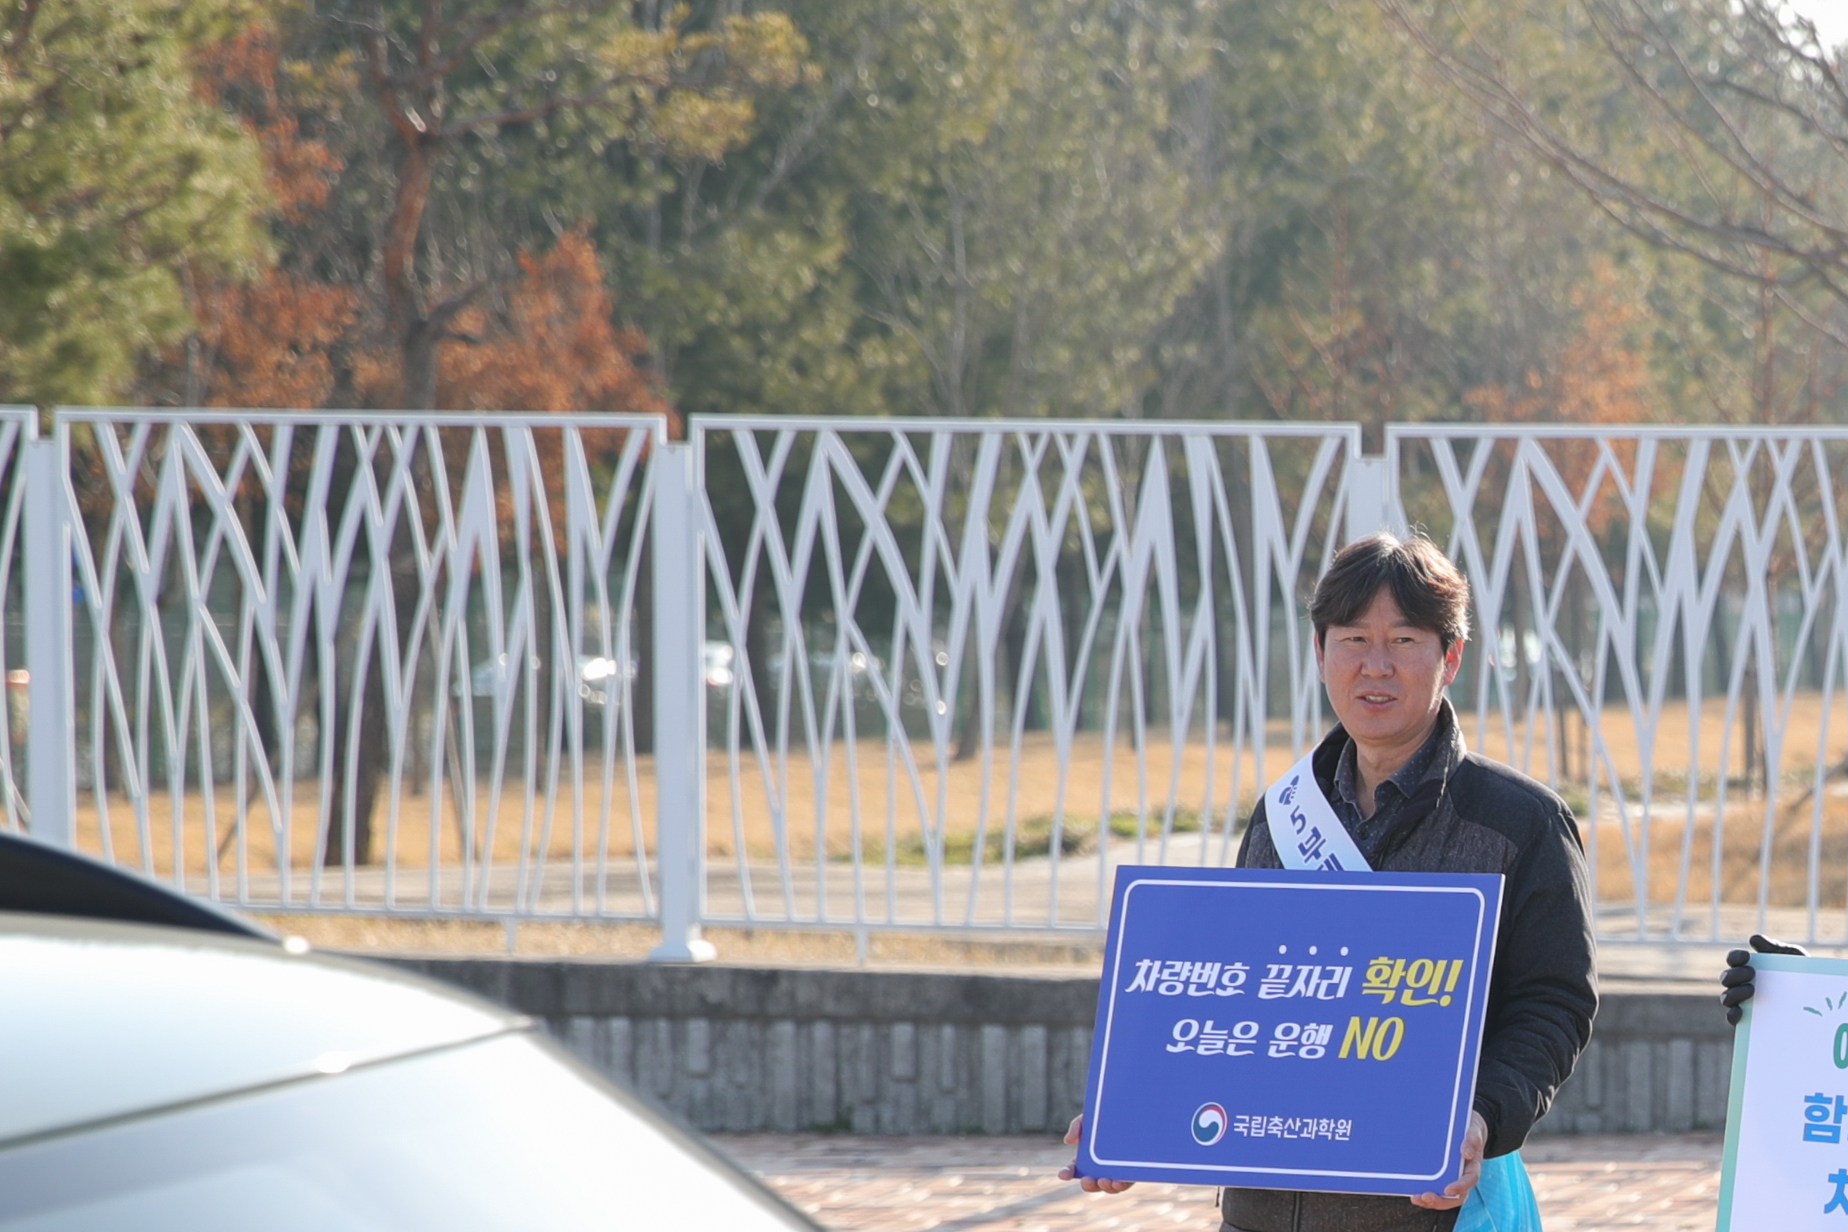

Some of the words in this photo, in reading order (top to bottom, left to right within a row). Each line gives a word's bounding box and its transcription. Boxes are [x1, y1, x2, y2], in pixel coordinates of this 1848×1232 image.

[1125, 958, 1250, 997] 차량번호
[1258, 964, 1353, 1000] 끝자리
[1361, 956, 1464, 1007] 확인!
[1166, 1018, 1260, 1056] 오늘은
[1267, 1022, 1333, 1060] 운행
[1338, 1016, 1405, 1062] NO
[1233, 1115, 1352, 1142] 국립축산과학원
